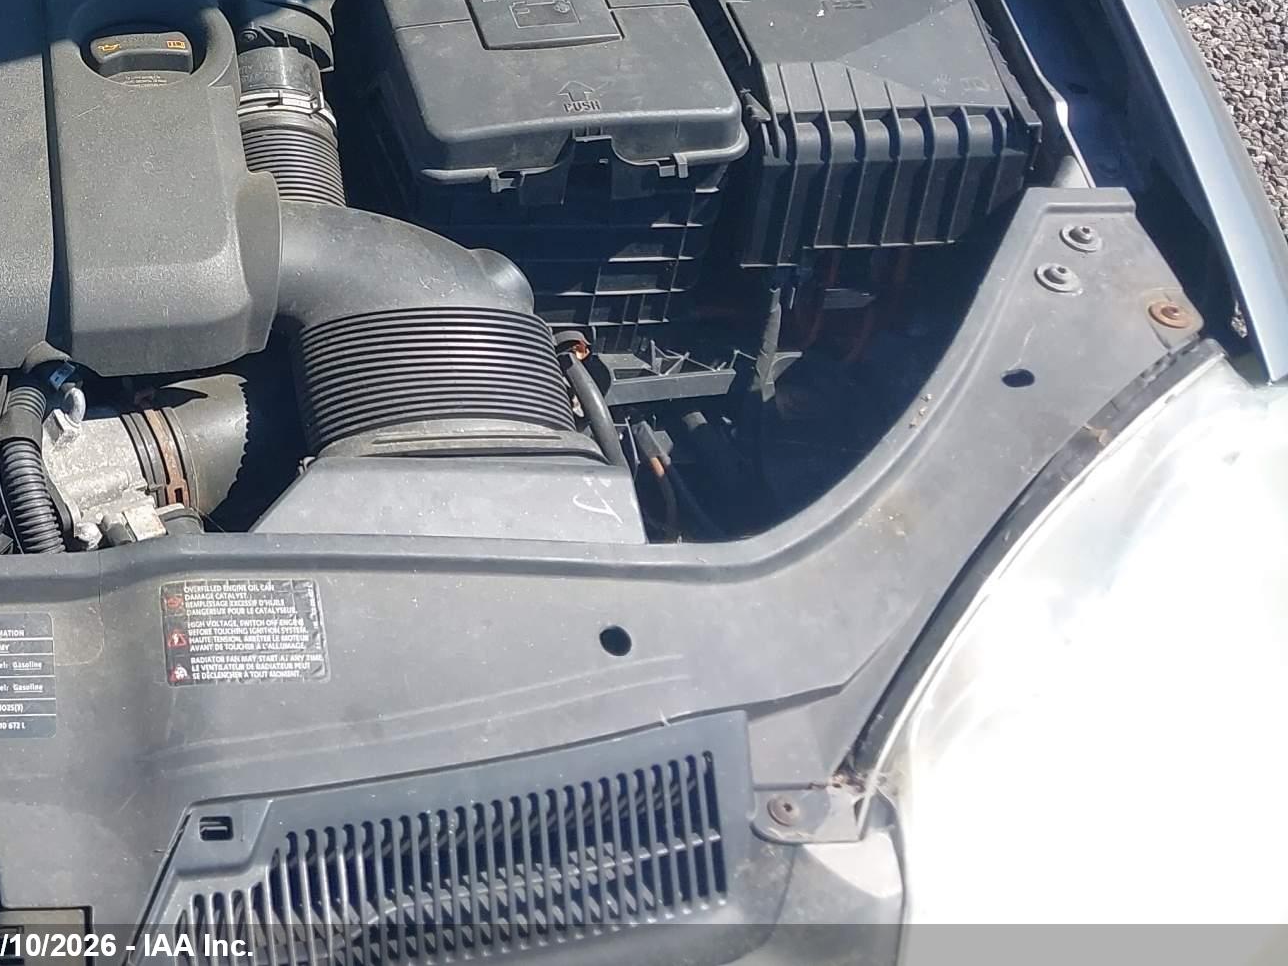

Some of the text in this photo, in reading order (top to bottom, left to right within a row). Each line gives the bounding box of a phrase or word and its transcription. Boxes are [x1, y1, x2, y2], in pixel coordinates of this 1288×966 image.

[563, 100, 601, 113] PUSH
[189, 628, 212, 636] BEFORE
[190, 636, 212, 644] HAUTE
[190, 644, 213, 652] AVANT
[190, 656, 225, 664] RADIATOR
